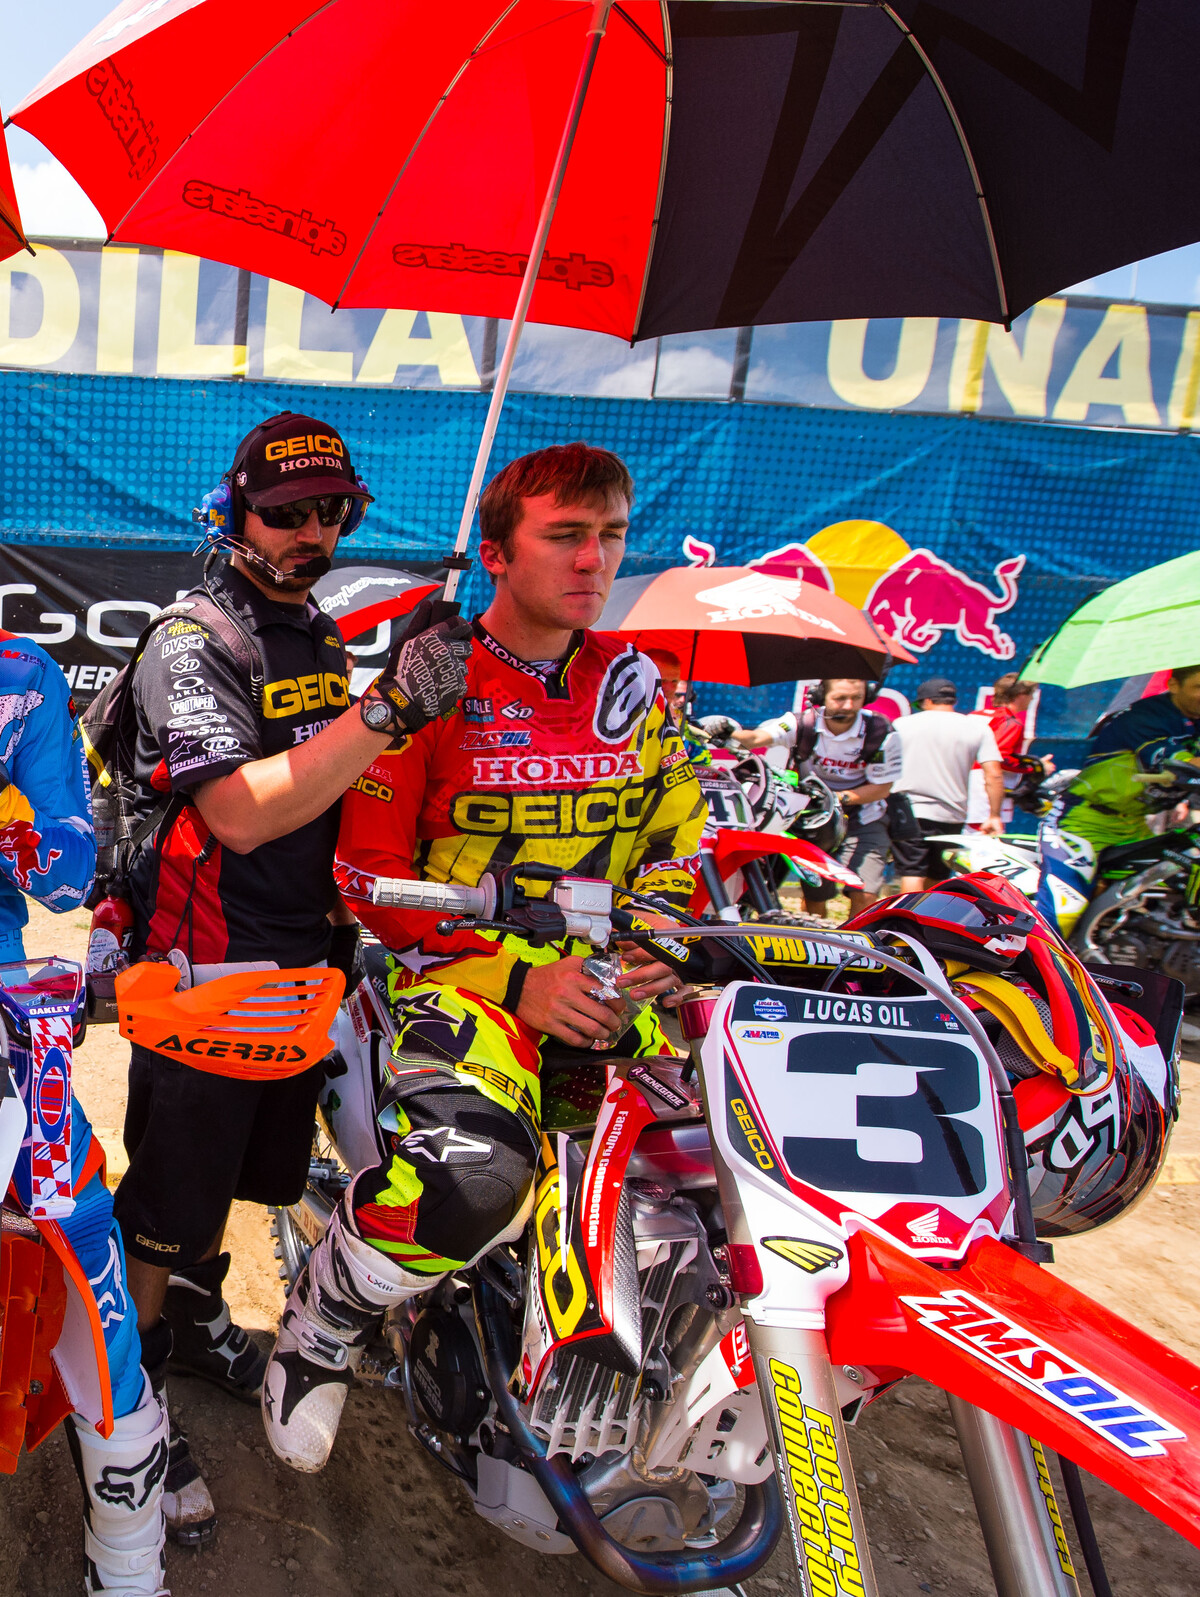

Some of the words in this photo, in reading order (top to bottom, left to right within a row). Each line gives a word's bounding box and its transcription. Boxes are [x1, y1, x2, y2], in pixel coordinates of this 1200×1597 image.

[265, 434, 344, 462] GEICO
[279, 456, 343, 473] HONDA
[707, 602, 847, 636] HONDA
[167, 686, 215, 701] OAKLEY
[472, 751, 643, 786] HONDA
[661, 750, 688, 768] HON
[982, 858, 1027, 880] 24
[28, 1005, 71, 1016] OAKLEY
[803, 999, 873, 1023] LUCAS
[878, 1005, 910, 1027] OIL
[155, 1035, 307, 1062] ACERBIS
[742, 1030, 767, 1039] AMA
[638, 1070, 685, 1109] RENEGADE
[783, 1031, 986, 1197] 3
[604, 1110, 629, 1158] Factory
[729, 1098, 774, 1170] GEICO
[588, 1157, 612, 1248] Connection
[135, 1232, 181, 1253] GEICO
[910, 1235, 953, 1244] HONDA
[900, 1290, 1187, 1458] AMSOIL
